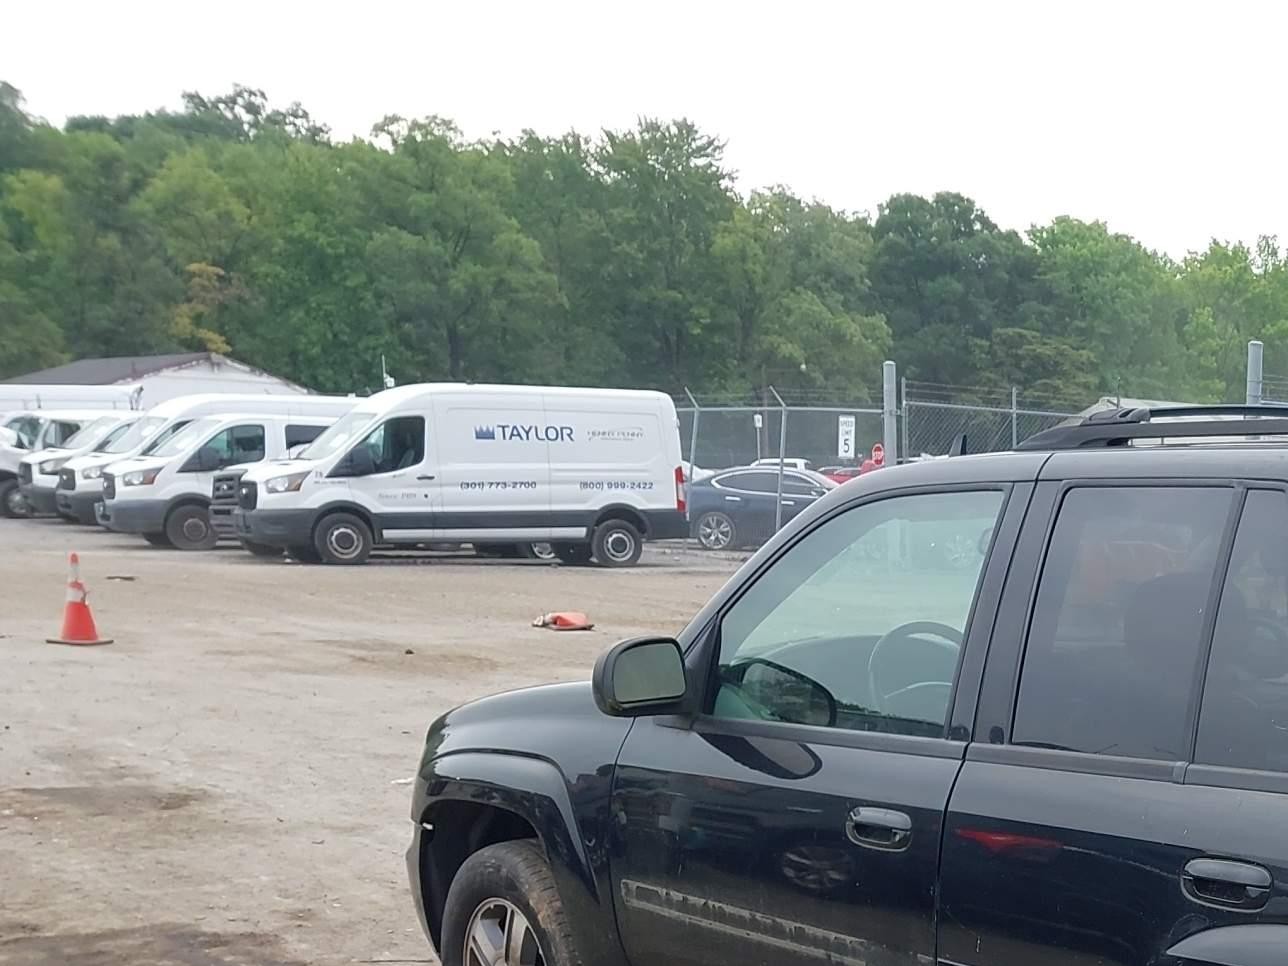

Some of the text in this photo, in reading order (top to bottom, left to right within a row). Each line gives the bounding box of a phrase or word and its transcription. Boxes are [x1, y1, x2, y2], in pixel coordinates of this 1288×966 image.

[497, 424, 575, 442] TAYLOR
[843, 438, 850, 453] 5
[459, 481, 537, 490] (301) 773-2700
[606, 481, 654, 490] 999-2422
